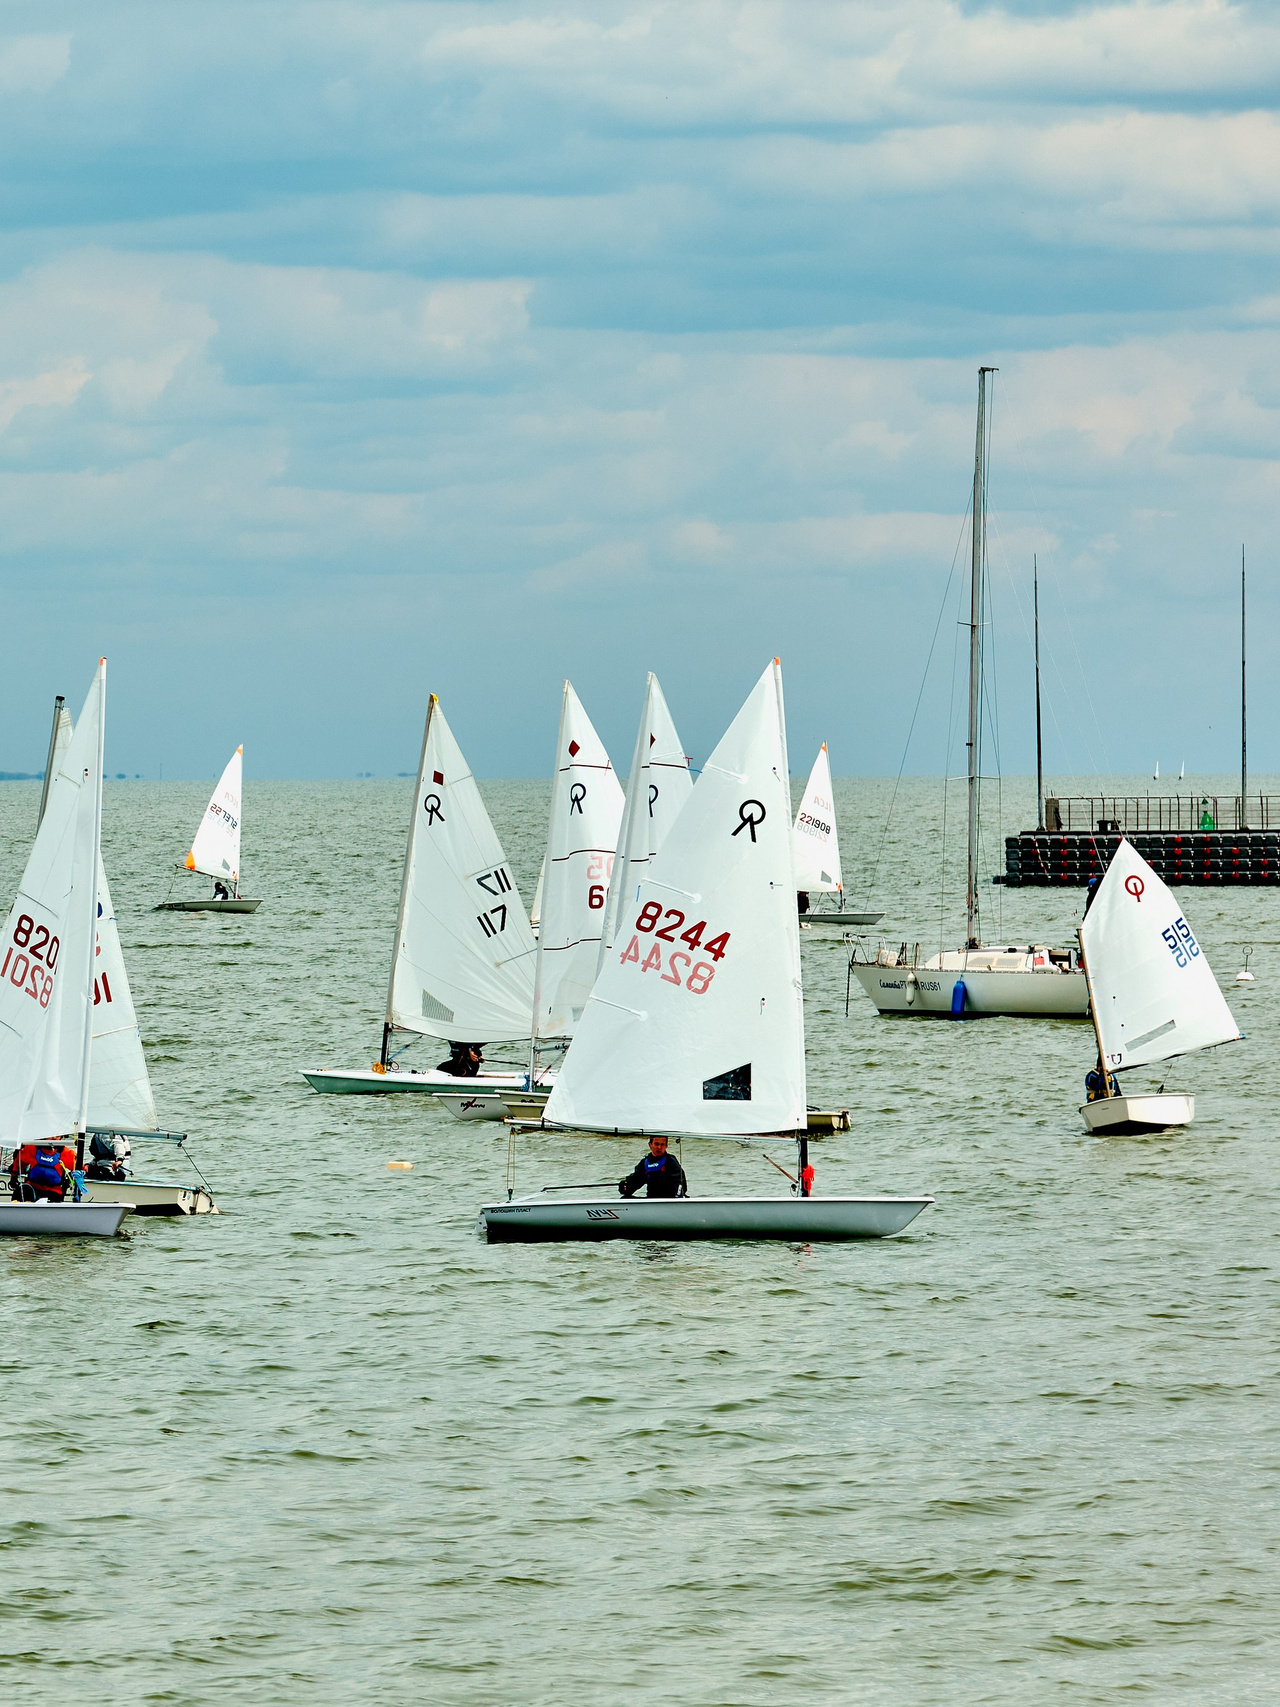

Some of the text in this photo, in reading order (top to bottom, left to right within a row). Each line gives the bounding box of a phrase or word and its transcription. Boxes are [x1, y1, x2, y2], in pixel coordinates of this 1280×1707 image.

[799, 812, 831, 834] 221908
[476, 904, 507, 938] 117
[635, 901, 731, 962] 8244
[1162, 917, 1191, 950] 515
